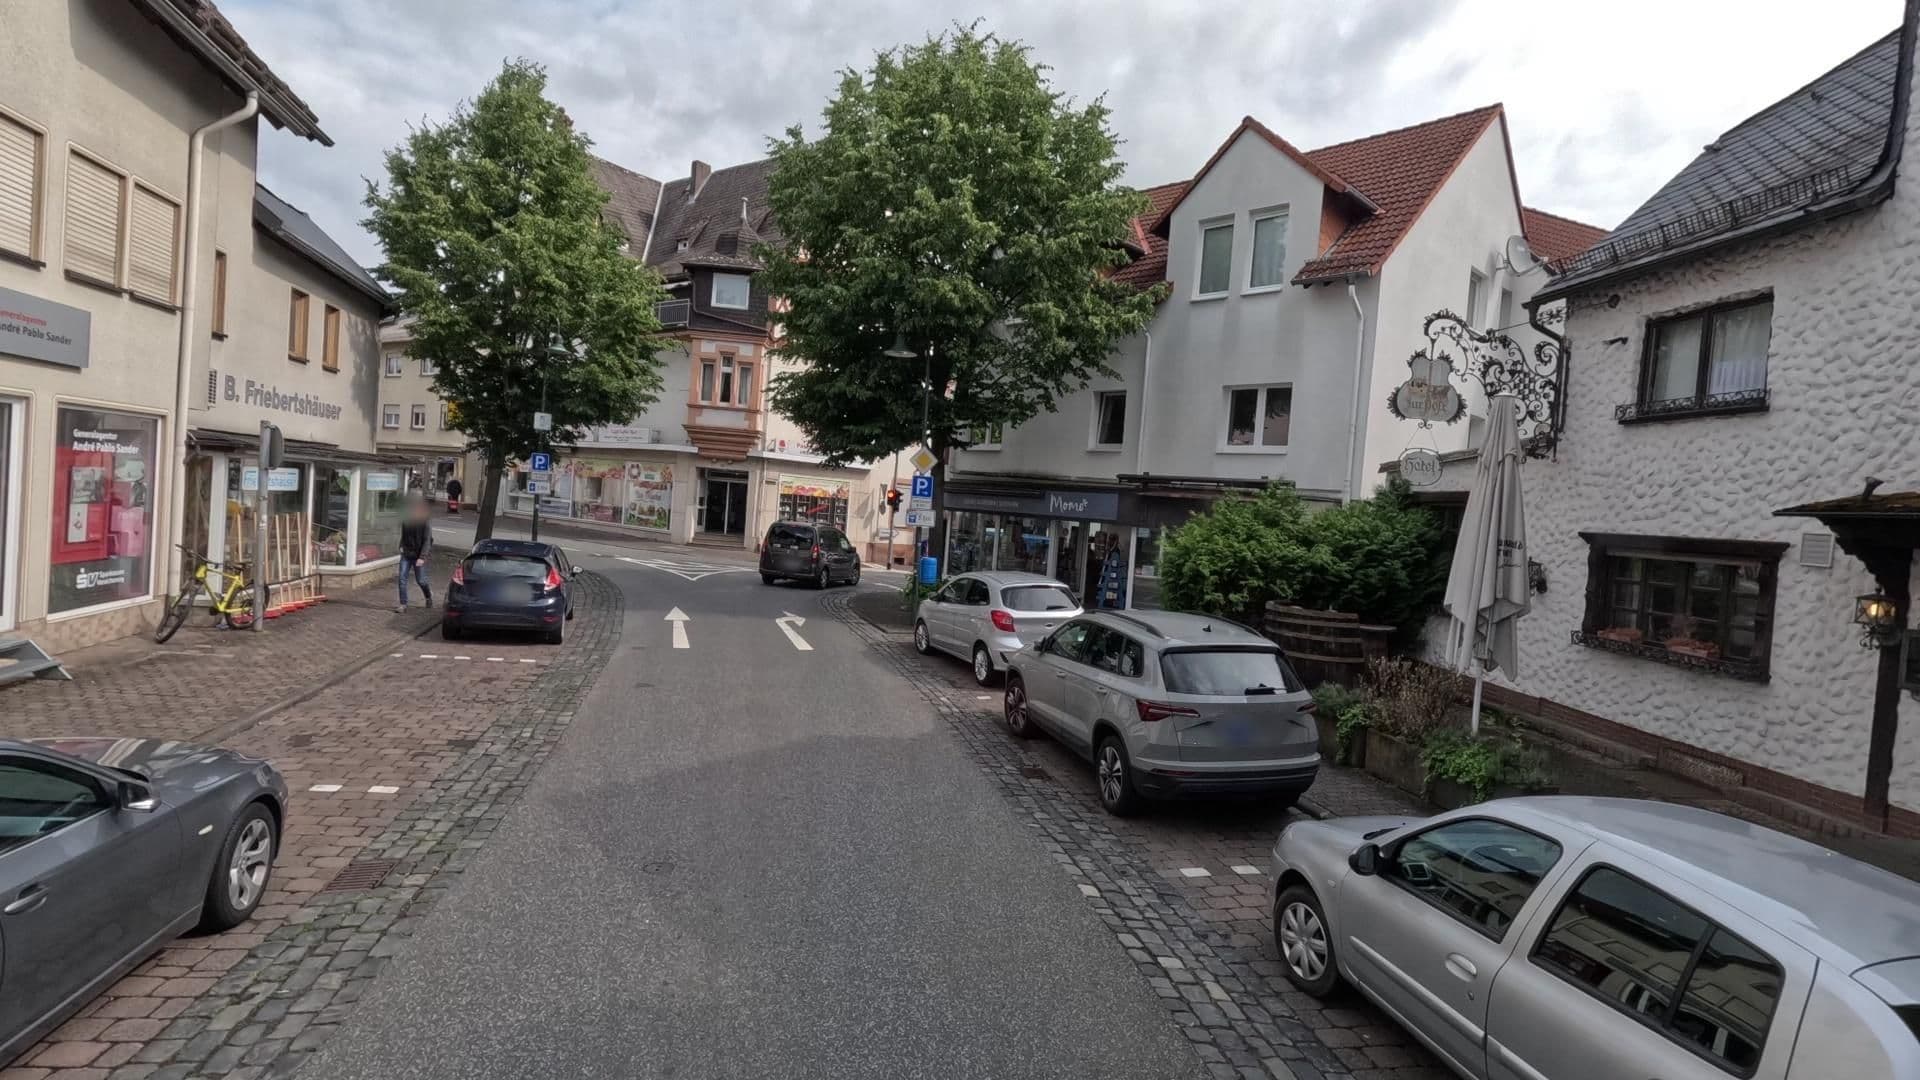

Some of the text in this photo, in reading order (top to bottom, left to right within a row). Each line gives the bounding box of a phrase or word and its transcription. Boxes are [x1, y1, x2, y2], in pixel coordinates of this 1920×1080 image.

[0, 323, 72, 345] ndré Pablo Sander
[224, 374, 342, 420] B. Friebertshäuser
[116, 444, 139, 454] Sander
[535, 456, 545, 468] P
[916, 478, 928, 495] P
